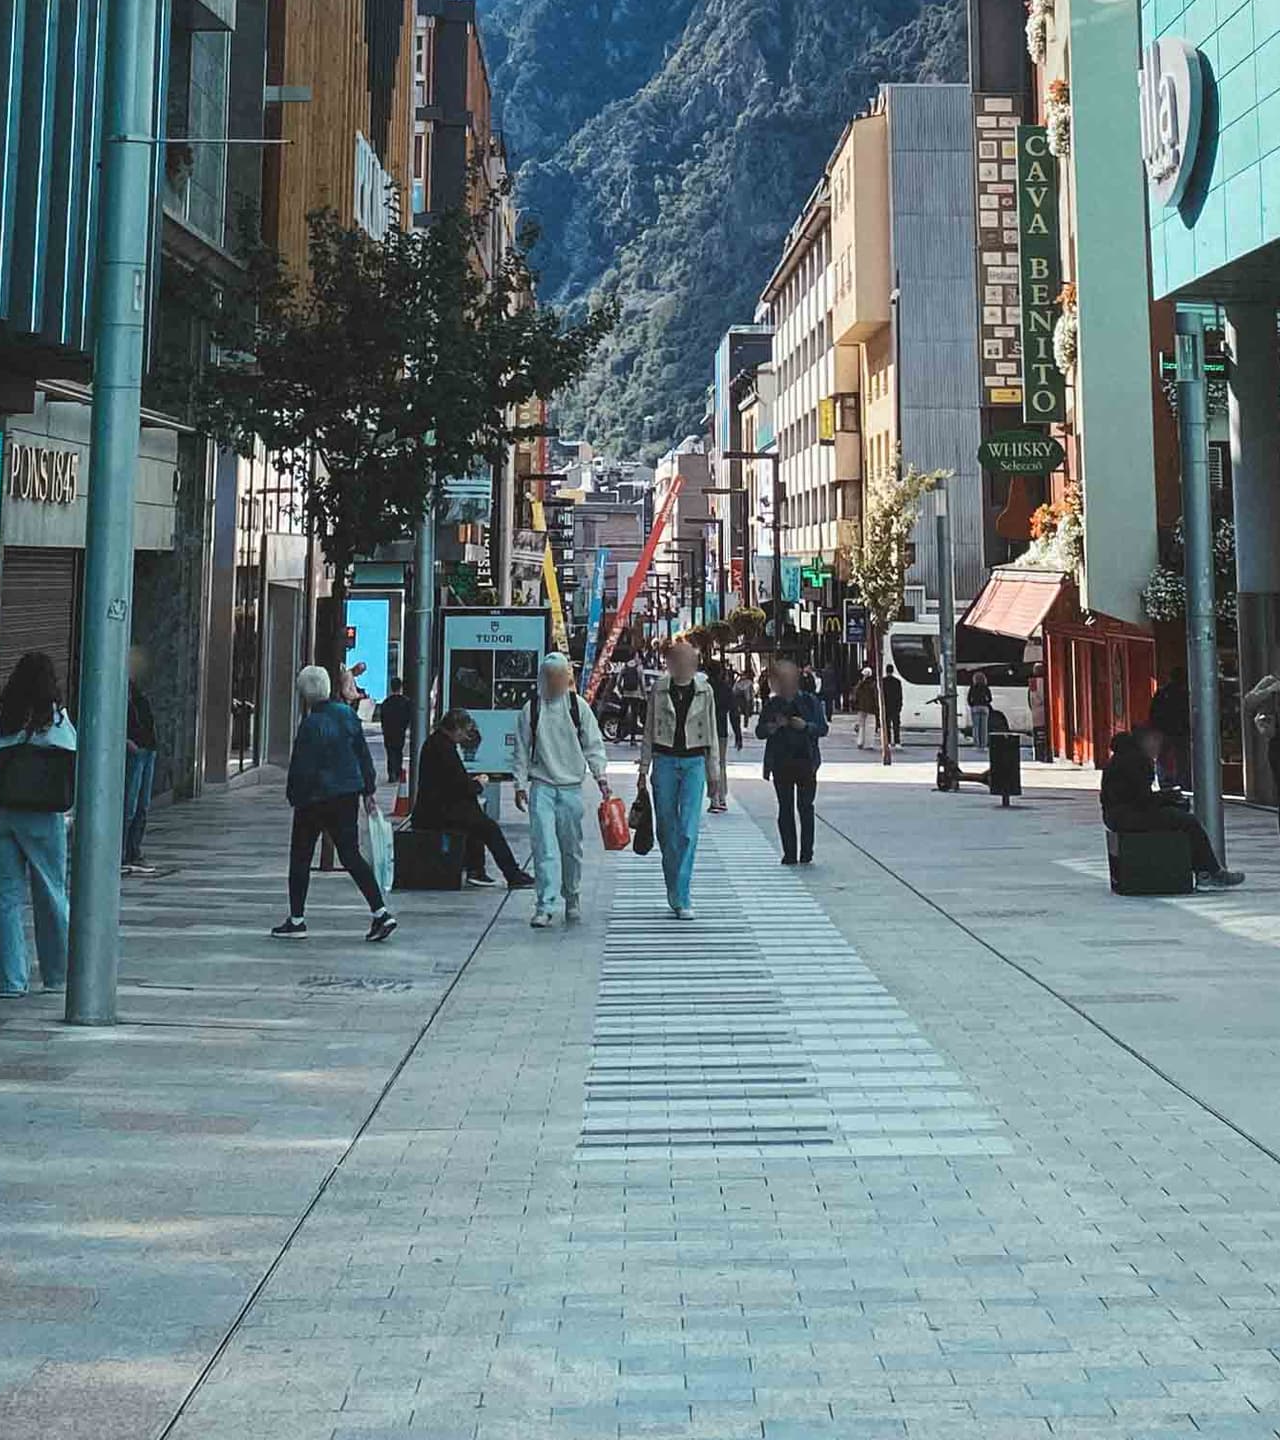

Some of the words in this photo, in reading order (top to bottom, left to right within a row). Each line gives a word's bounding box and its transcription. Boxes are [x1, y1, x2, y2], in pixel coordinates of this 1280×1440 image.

[1025, 135, 1049, 234] CAVA
[1028, 257, 1056, 413] BENITO
[9, 443, 49, 501] PONS
[50, 451, 79, 504] 1845
[987, 441, 1054, 458] WHISKY
[476, 634, 512, 644] TUDOR
